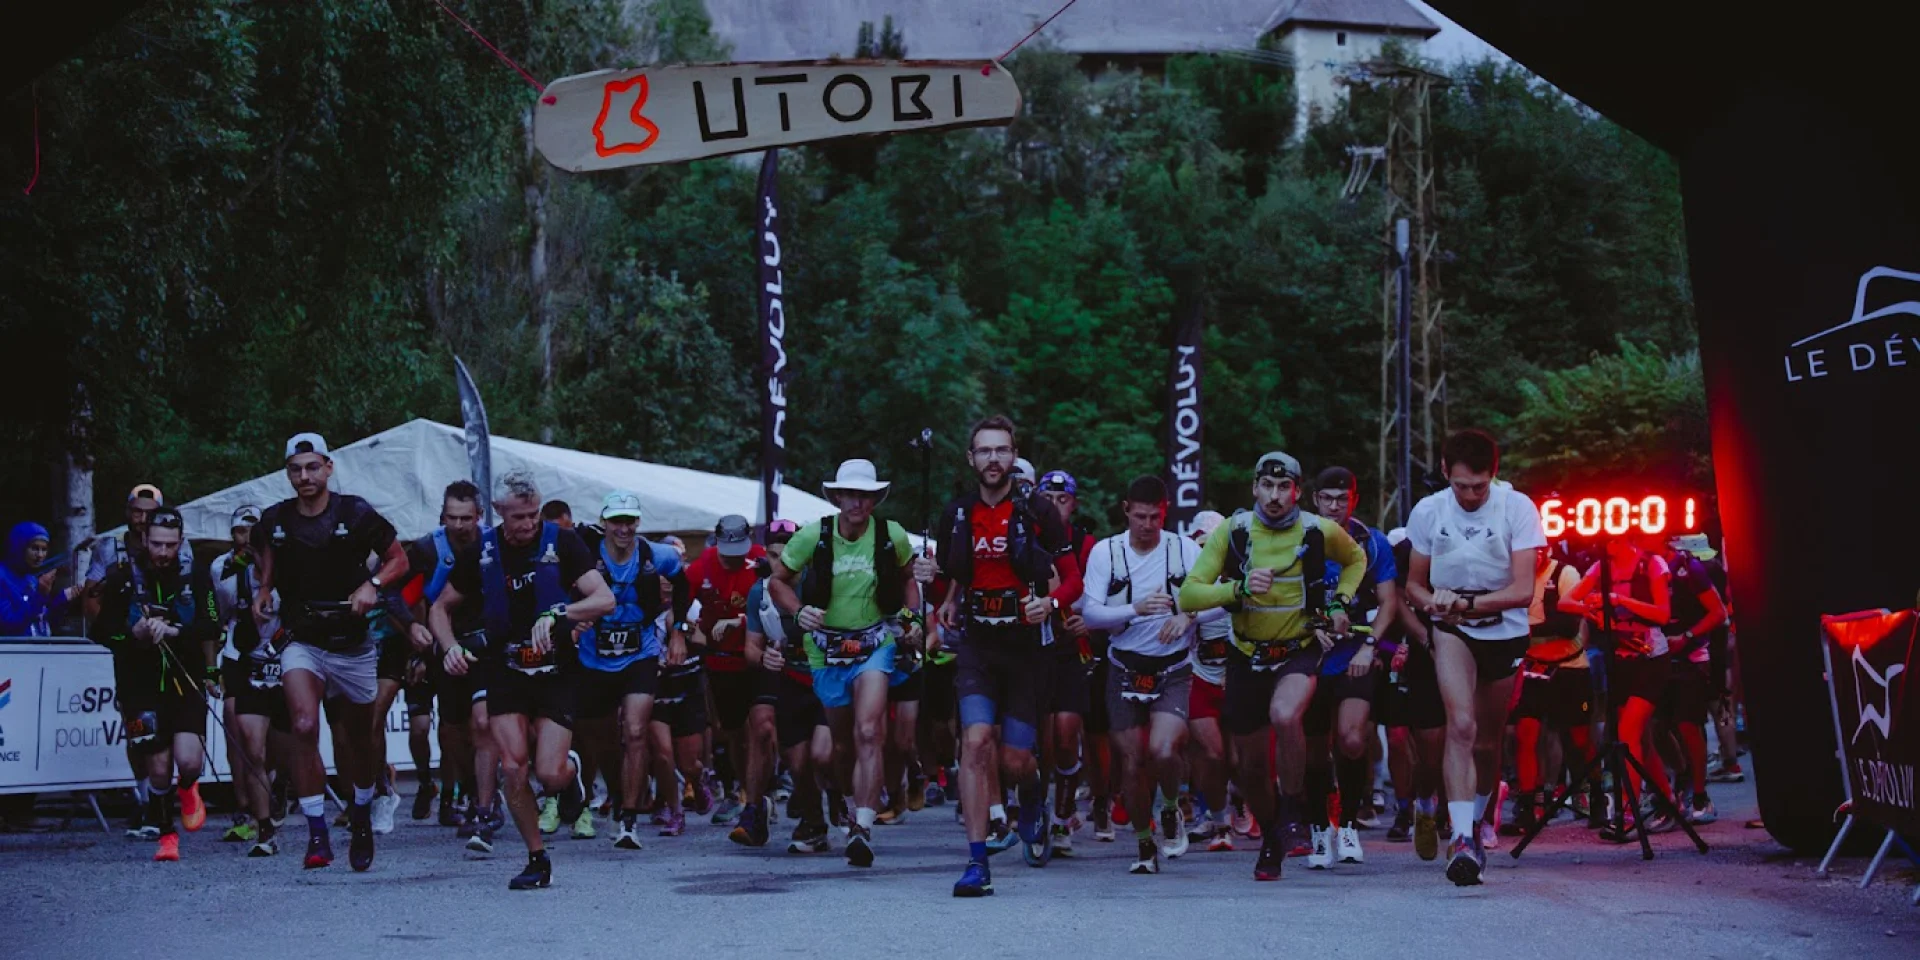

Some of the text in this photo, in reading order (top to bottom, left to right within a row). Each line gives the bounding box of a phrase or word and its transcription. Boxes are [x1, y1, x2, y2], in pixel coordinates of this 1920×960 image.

[693, 73, 963, 142] UTOBI
[1784, 349, 1828, 382] LE
[1171, 345, 1201, 508] DÉVOLUY
[972, 536, 1008, 552] AS
[608, 631, 628, 644] 477
[262, 663, 281, 676] 473
